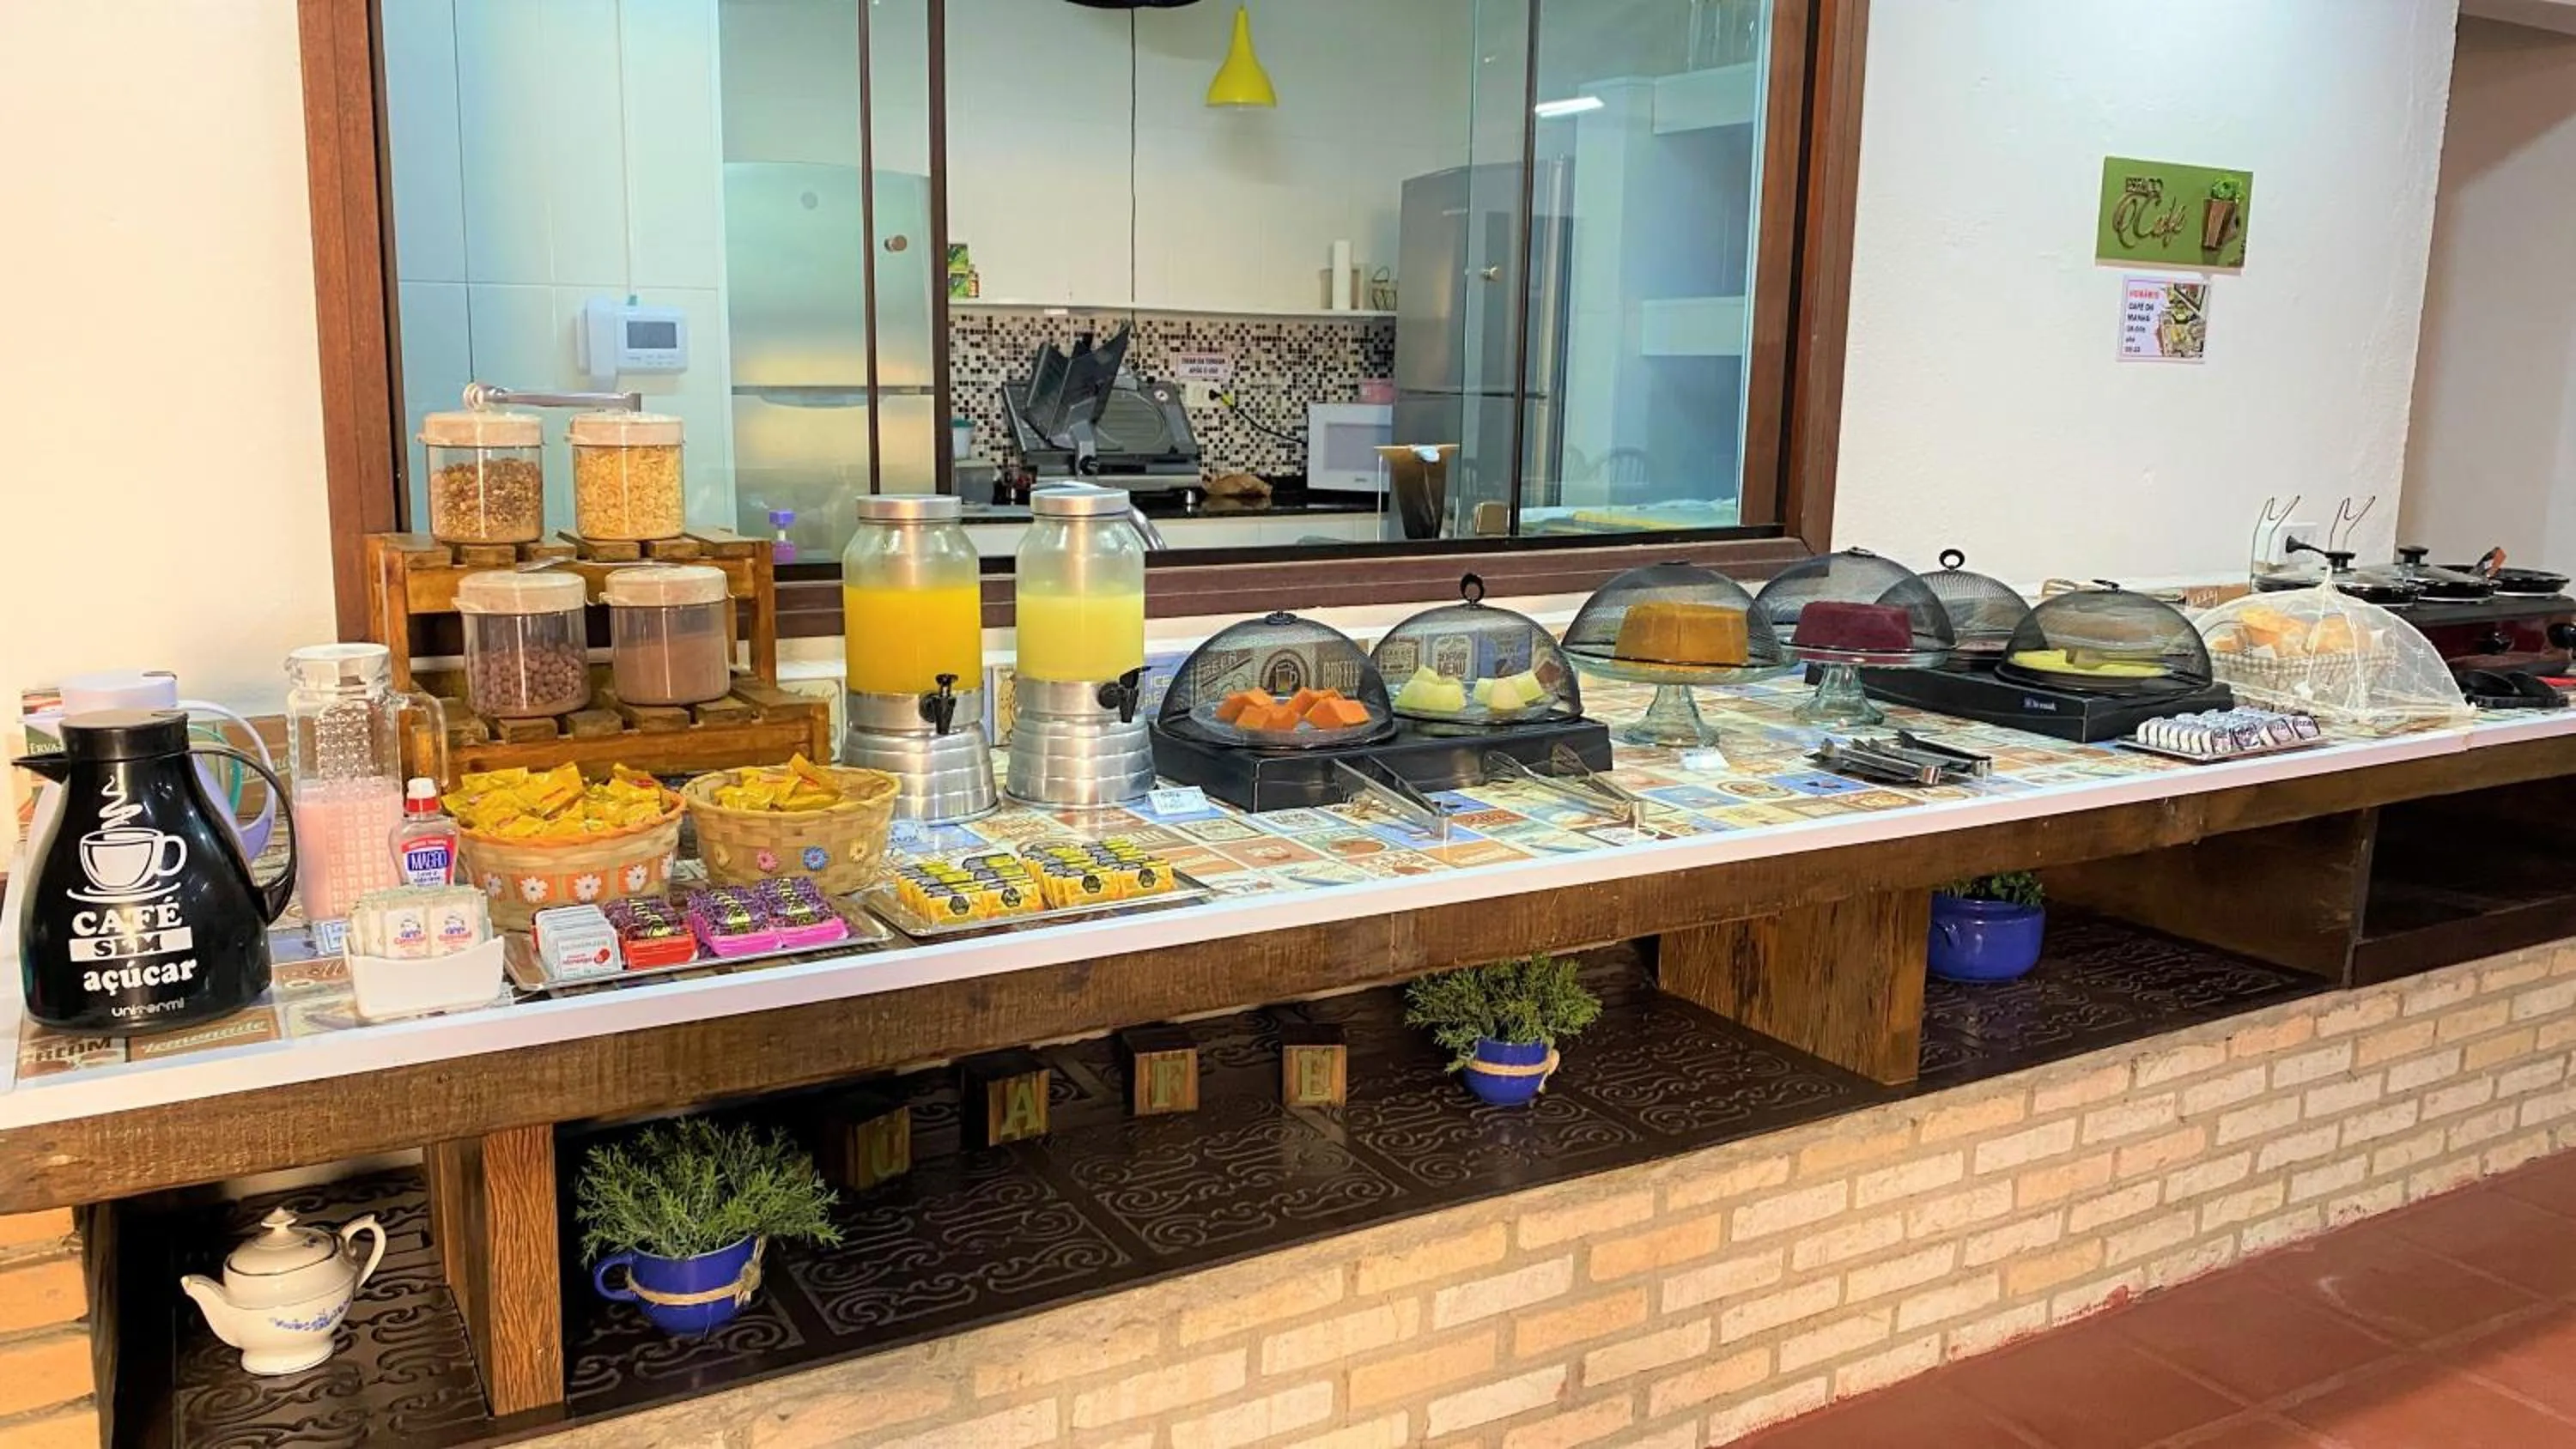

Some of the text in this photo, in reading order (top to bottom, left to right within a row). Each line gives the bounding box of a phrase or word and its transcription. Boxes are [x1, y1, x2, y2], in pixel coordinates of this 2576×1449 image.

[72, 896, 182, 937] CAFÉ
[94, 934, 162, 957] SEM
[83, 959, 197, 997] açúcar
